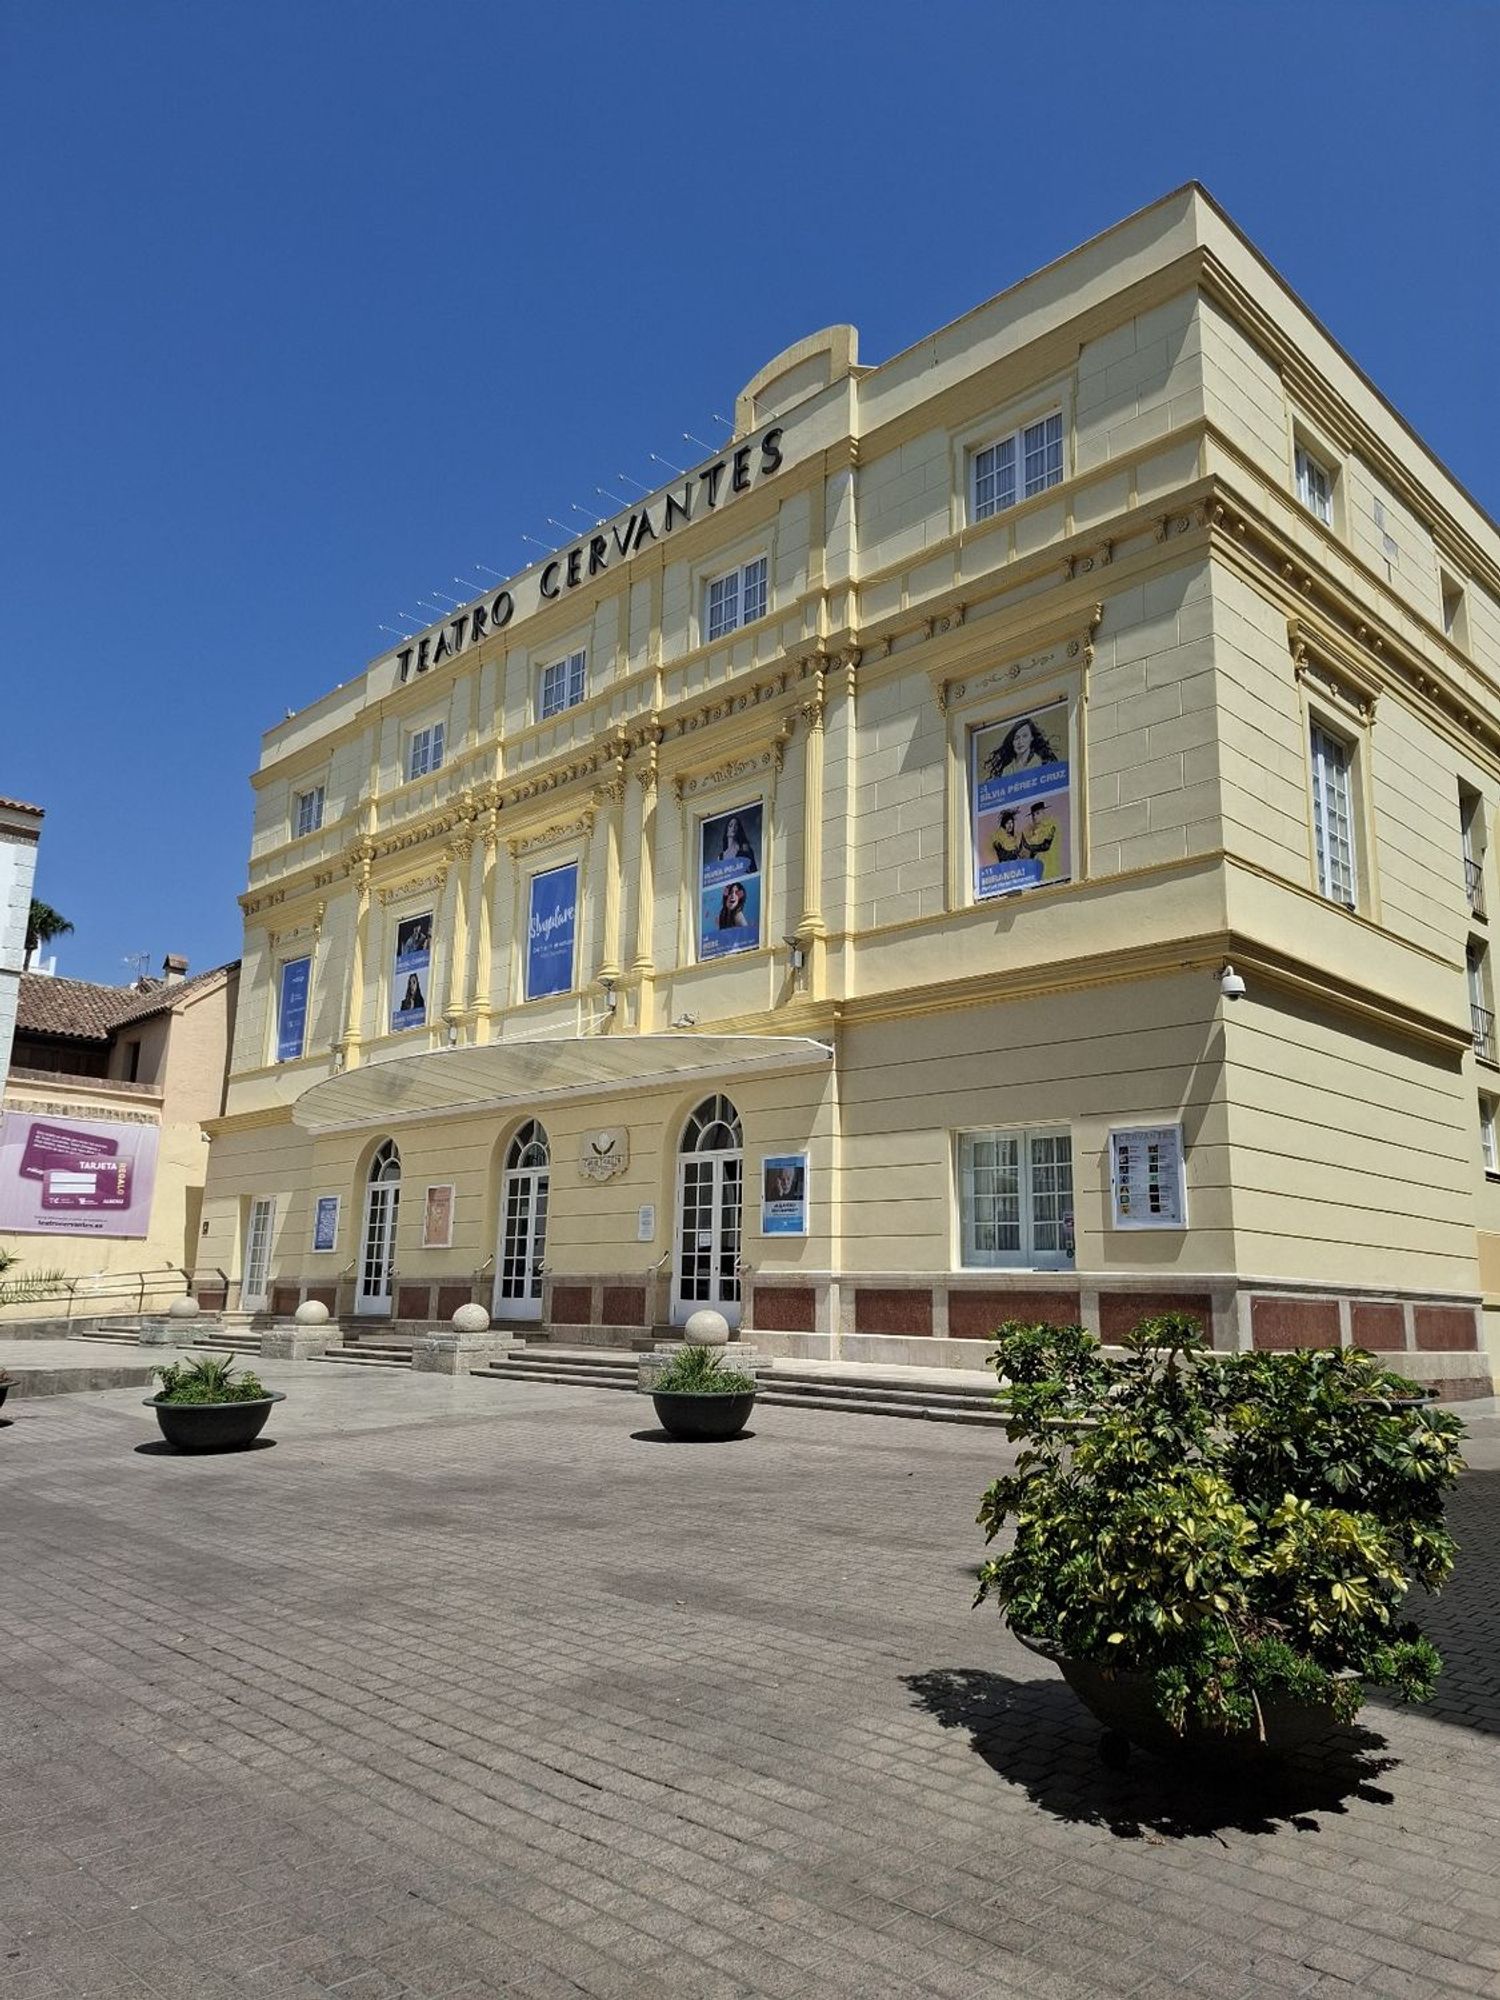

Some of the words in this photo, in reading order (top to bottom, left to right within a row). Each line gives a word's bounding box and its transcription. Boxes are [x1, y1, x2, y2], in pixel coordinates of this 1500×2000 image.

[397, 591, 514, 682] TEATRO
[540, 427, 784, 599] CERVANTES
[1040, 769, 1066, 784] CRUZ
[79, 1161, 118, 1171] TARJETA
[116, 1162, 128, 1196] REGALO
